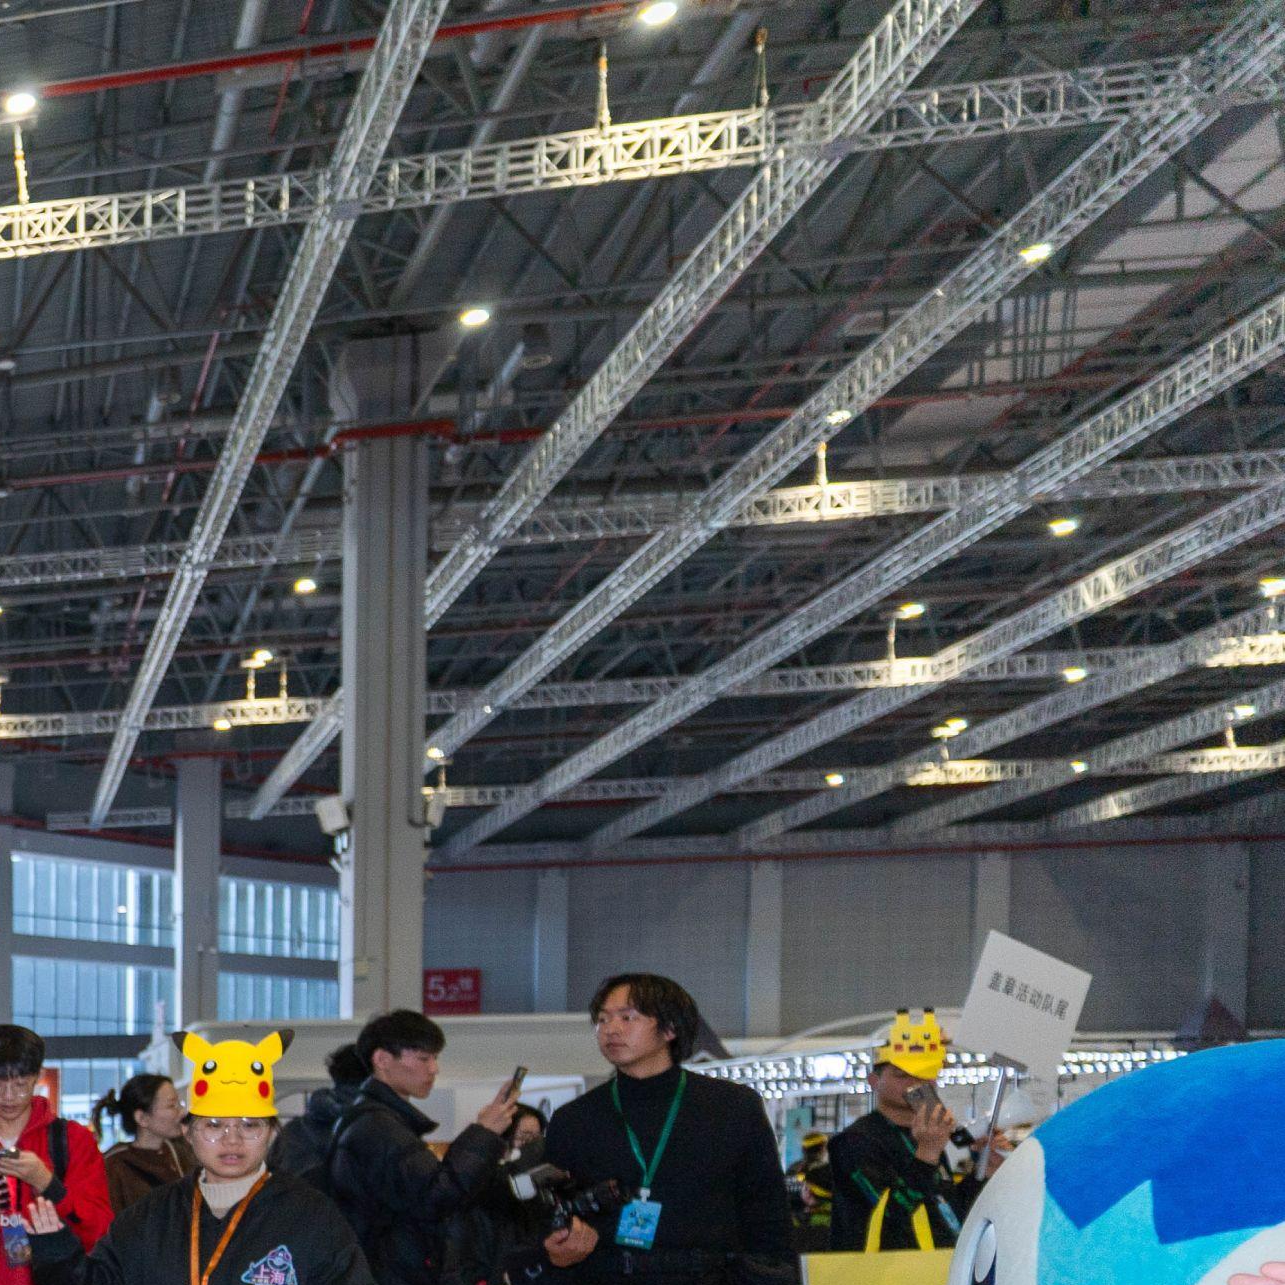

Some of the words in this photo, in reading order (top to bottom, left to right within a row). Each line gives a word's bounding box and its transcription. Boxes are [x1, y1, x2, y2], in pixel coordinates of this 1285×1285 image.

[989, 969, 1070, 1021] 盖章活动队尾
[254, 1264, 286, 1285] 上海
